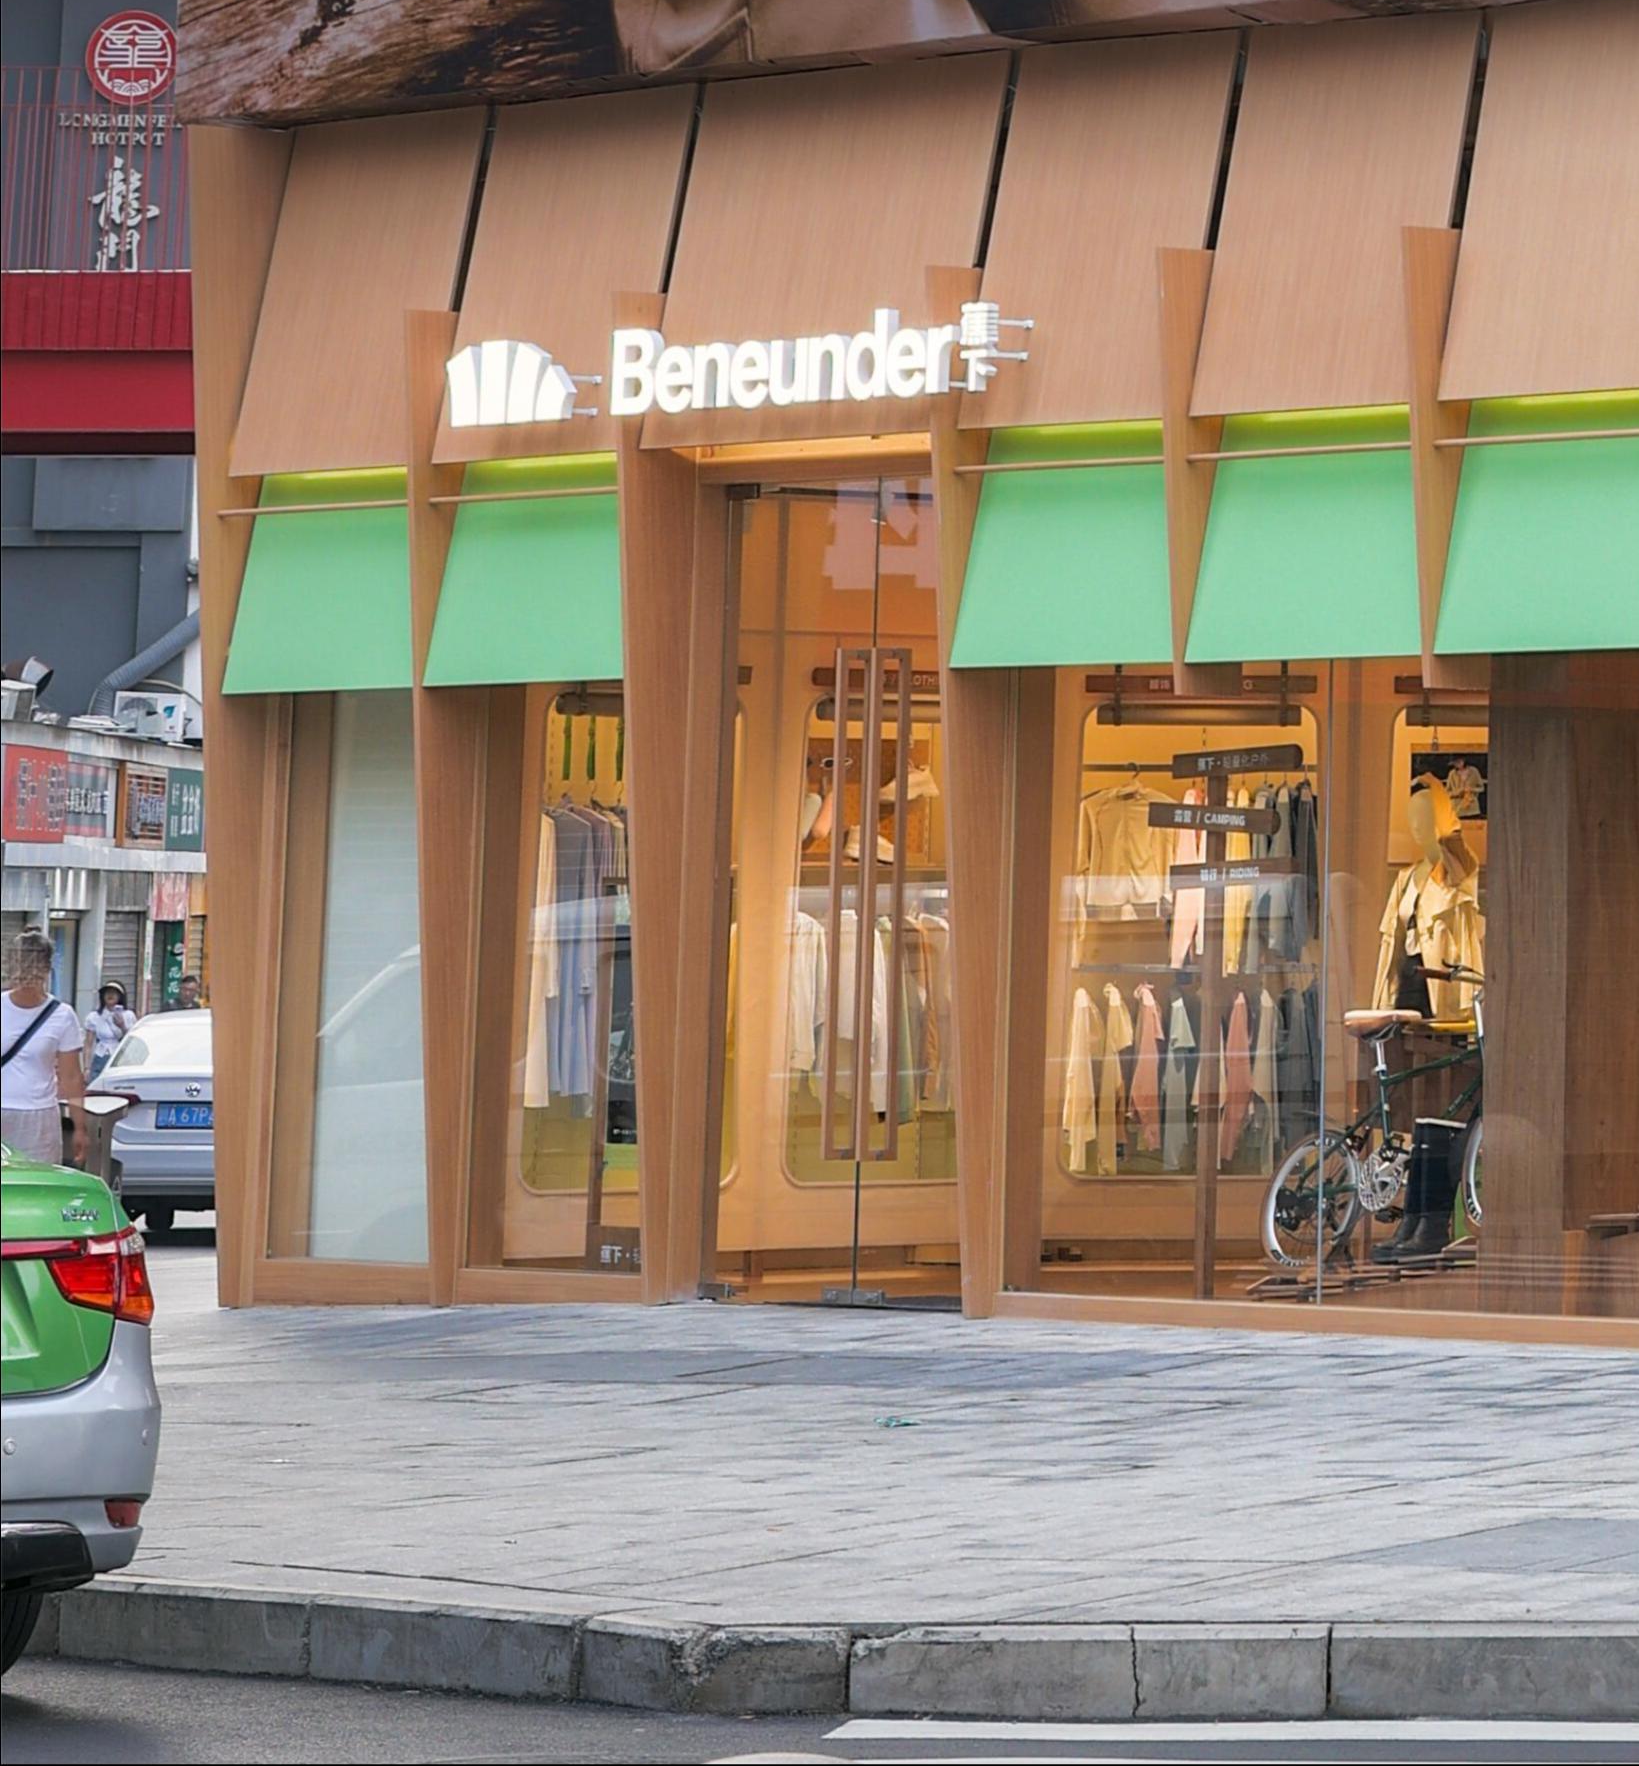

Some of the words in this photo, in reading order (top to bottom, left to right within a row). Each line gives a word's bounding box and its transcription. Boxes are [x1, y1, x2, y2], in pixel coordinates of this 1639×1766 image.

[91, 130, 166, 146] HOTPOT
[610, 305, 959, 417] Beneunder
[1204, 812, 1246, 827] CAMPING
[1230, 866, 1260, 880] RIDING
